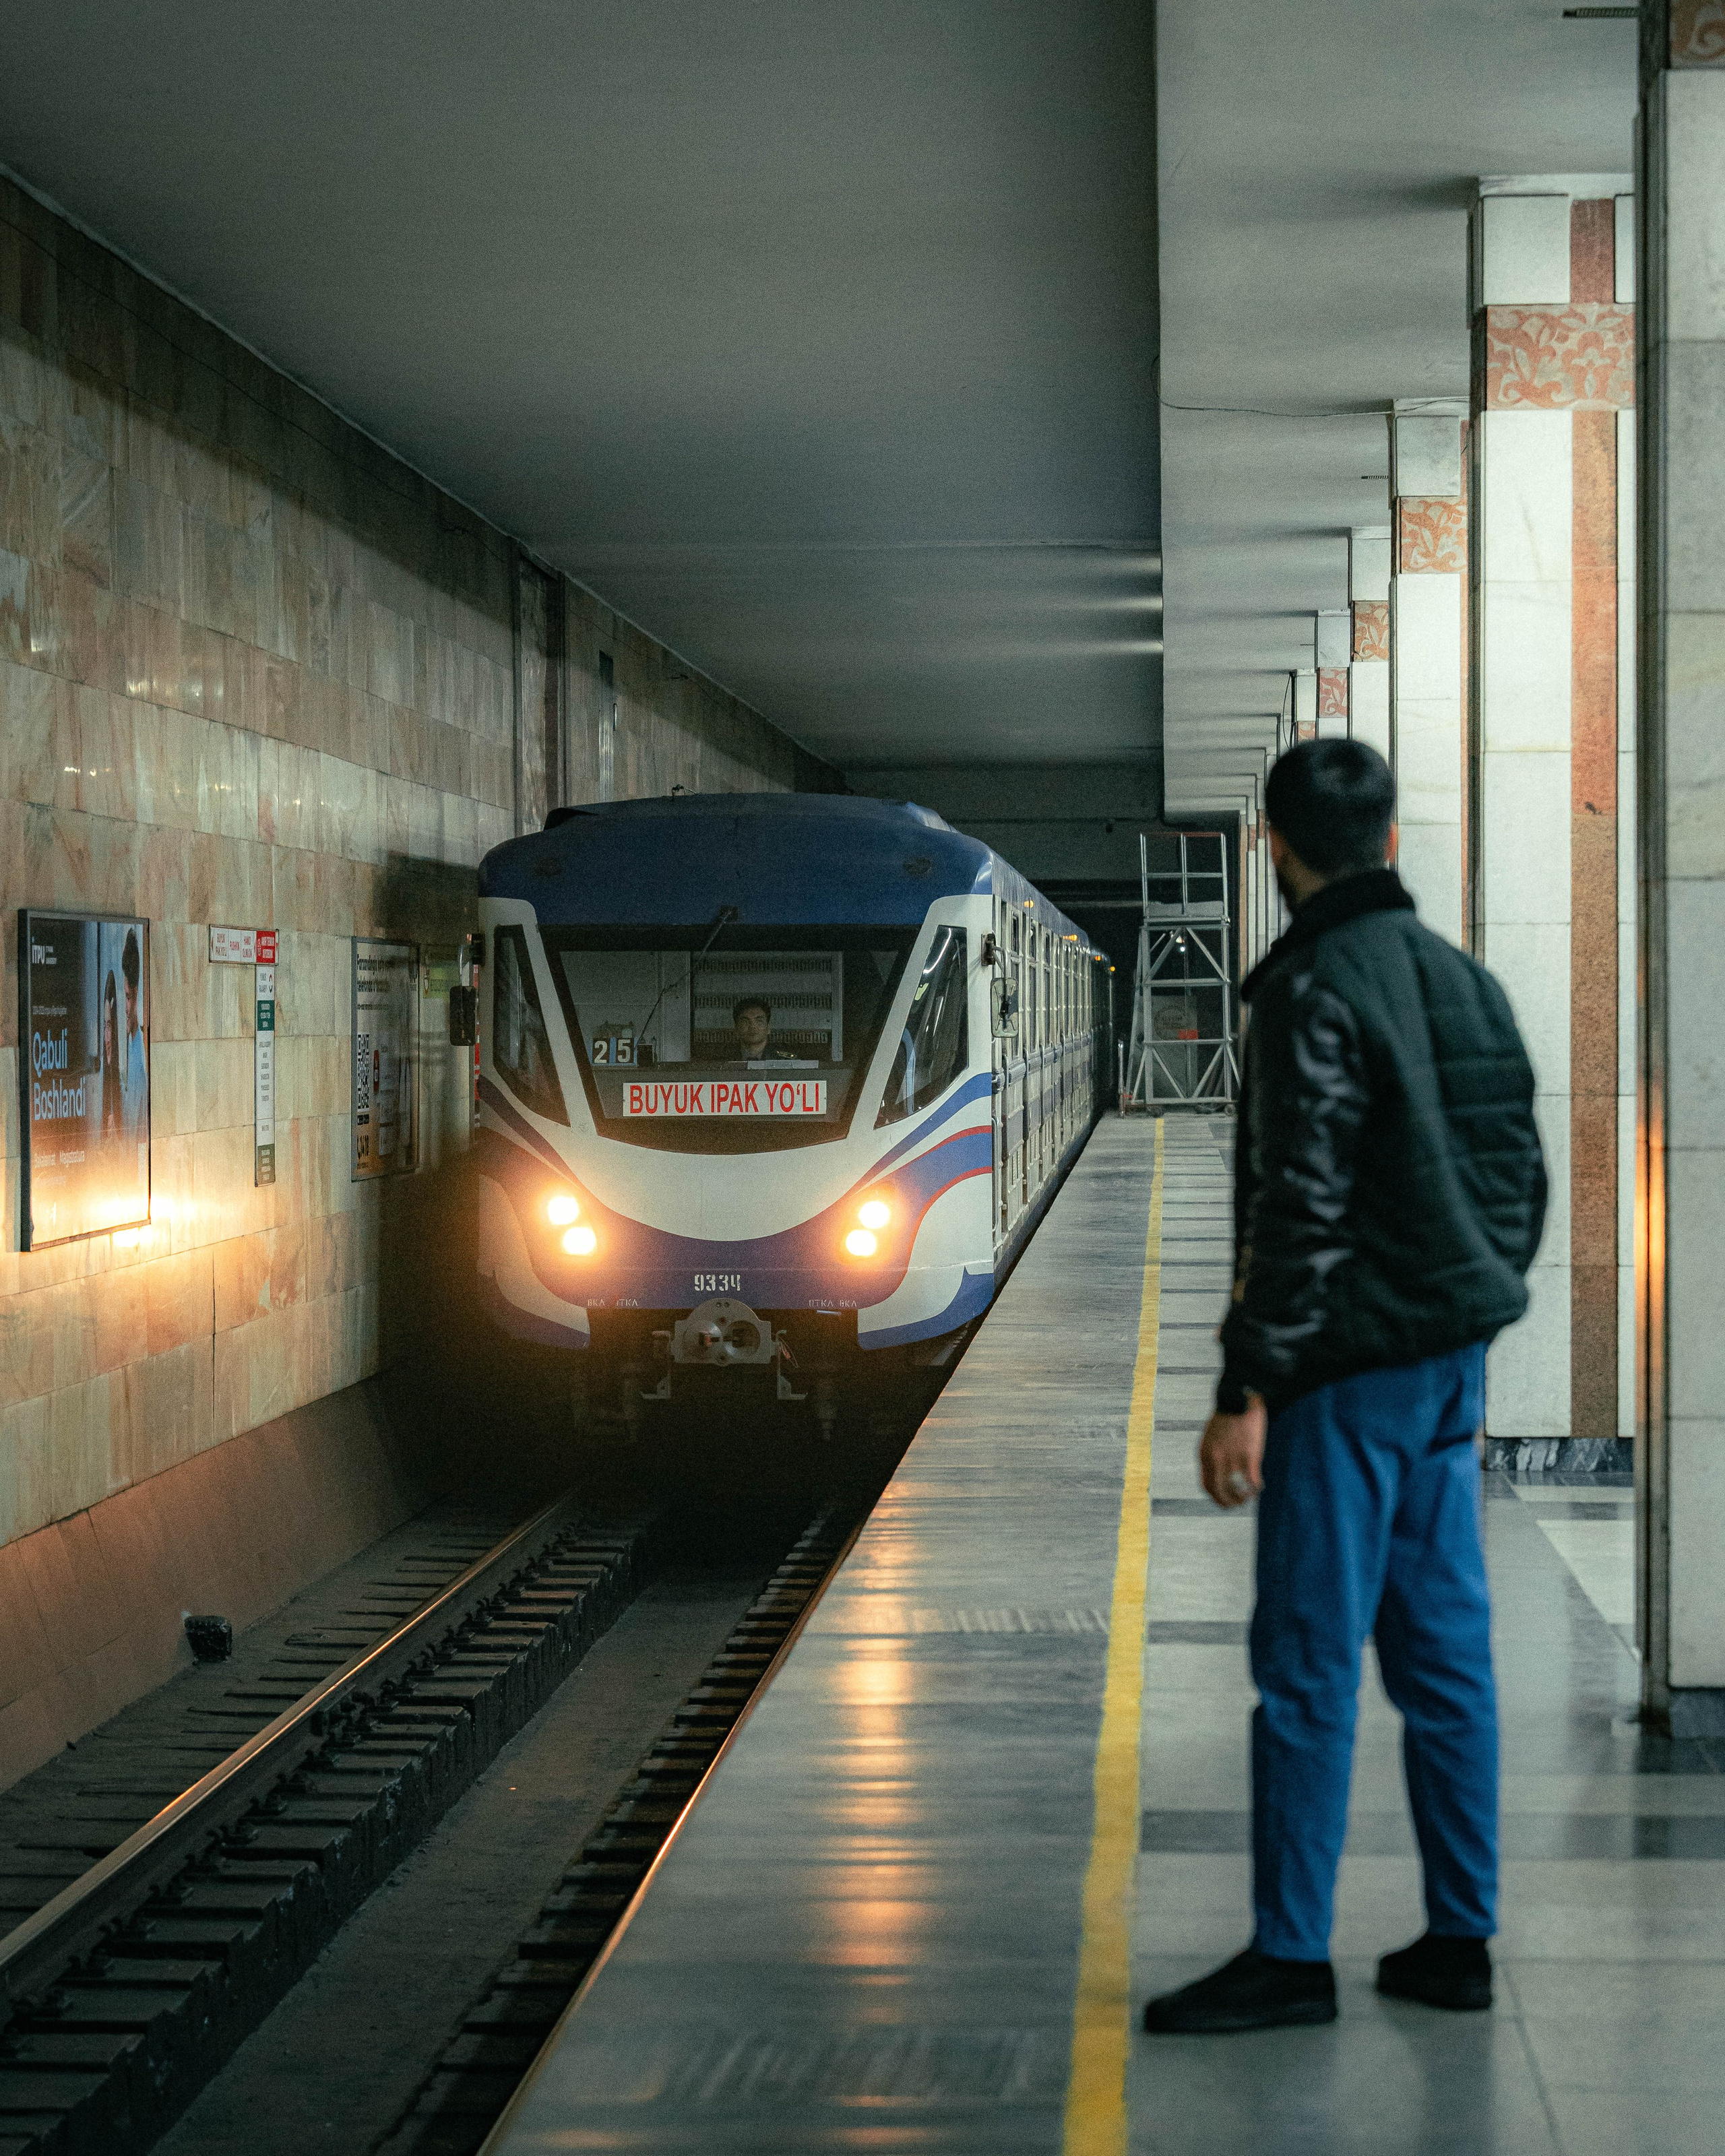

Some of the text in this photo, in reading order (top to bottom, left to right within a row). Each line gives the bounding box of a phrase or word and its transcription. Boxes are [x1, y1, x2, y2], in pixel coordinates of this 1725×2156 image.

[33, 1028, 67, 1078] Qabuli
[594, 1039, 631, 1064] 25
[34, 1077, 86, 1120] Boshlandi
[630, 1084, 703, 1114] BUYUK
[711, 1083, 759, 1113] IPAK
[694, 1275, 741, 1292] 9334
